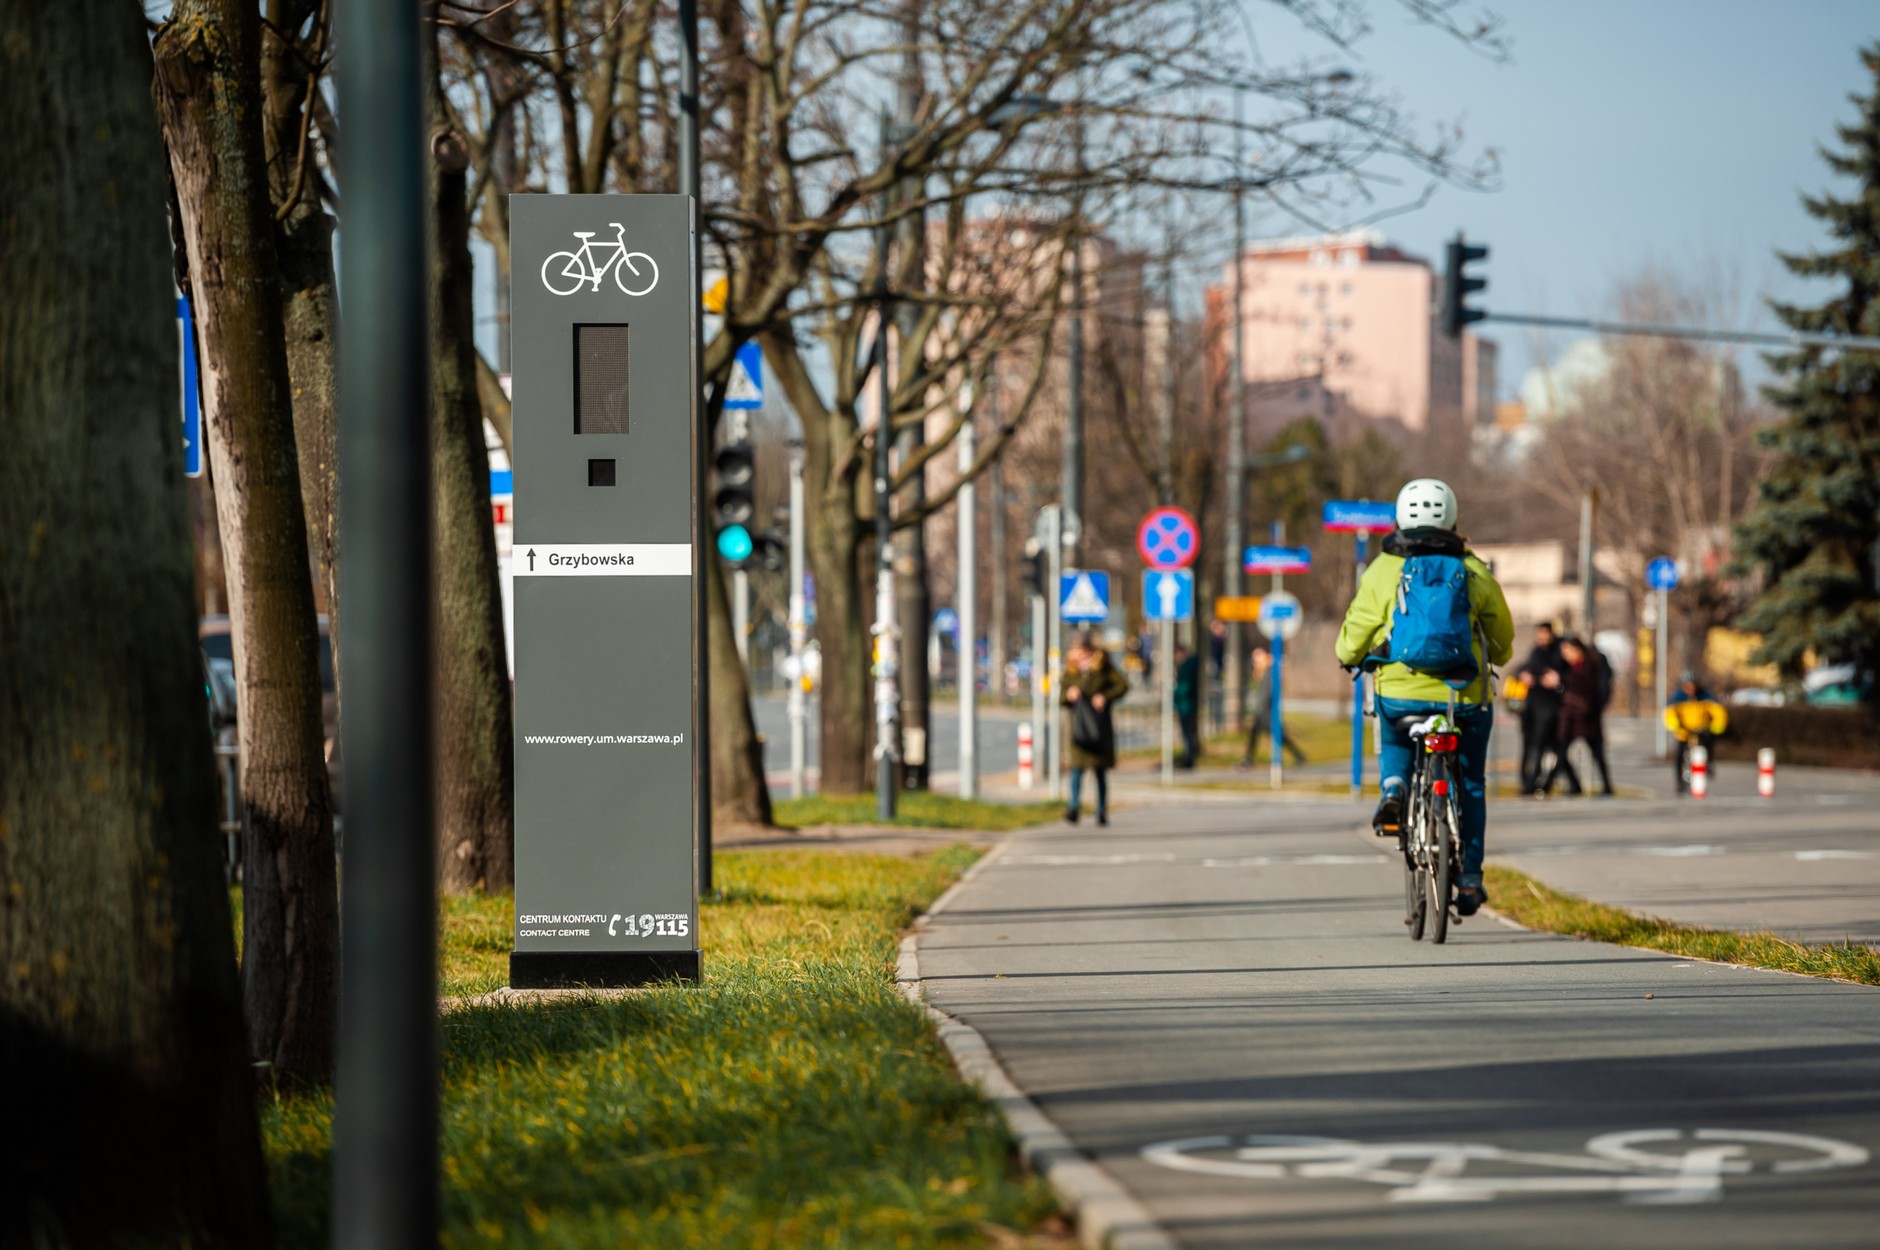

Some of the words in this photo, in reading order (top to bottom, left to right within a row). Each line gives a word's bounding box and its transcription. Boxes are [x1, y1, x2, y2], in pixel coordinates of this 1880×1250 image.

[548, 553, 635, 568] Grzybowska
[524, 733, 684, 746] www.rowery.um.warszawa.pl
[519, 914, 561, 924] CENTRUM
[562, 914, 607, 924] KONTAKTU
[519, 929, 557, 937] CONTACT
[558, 929, 590, 937] CENTRE
